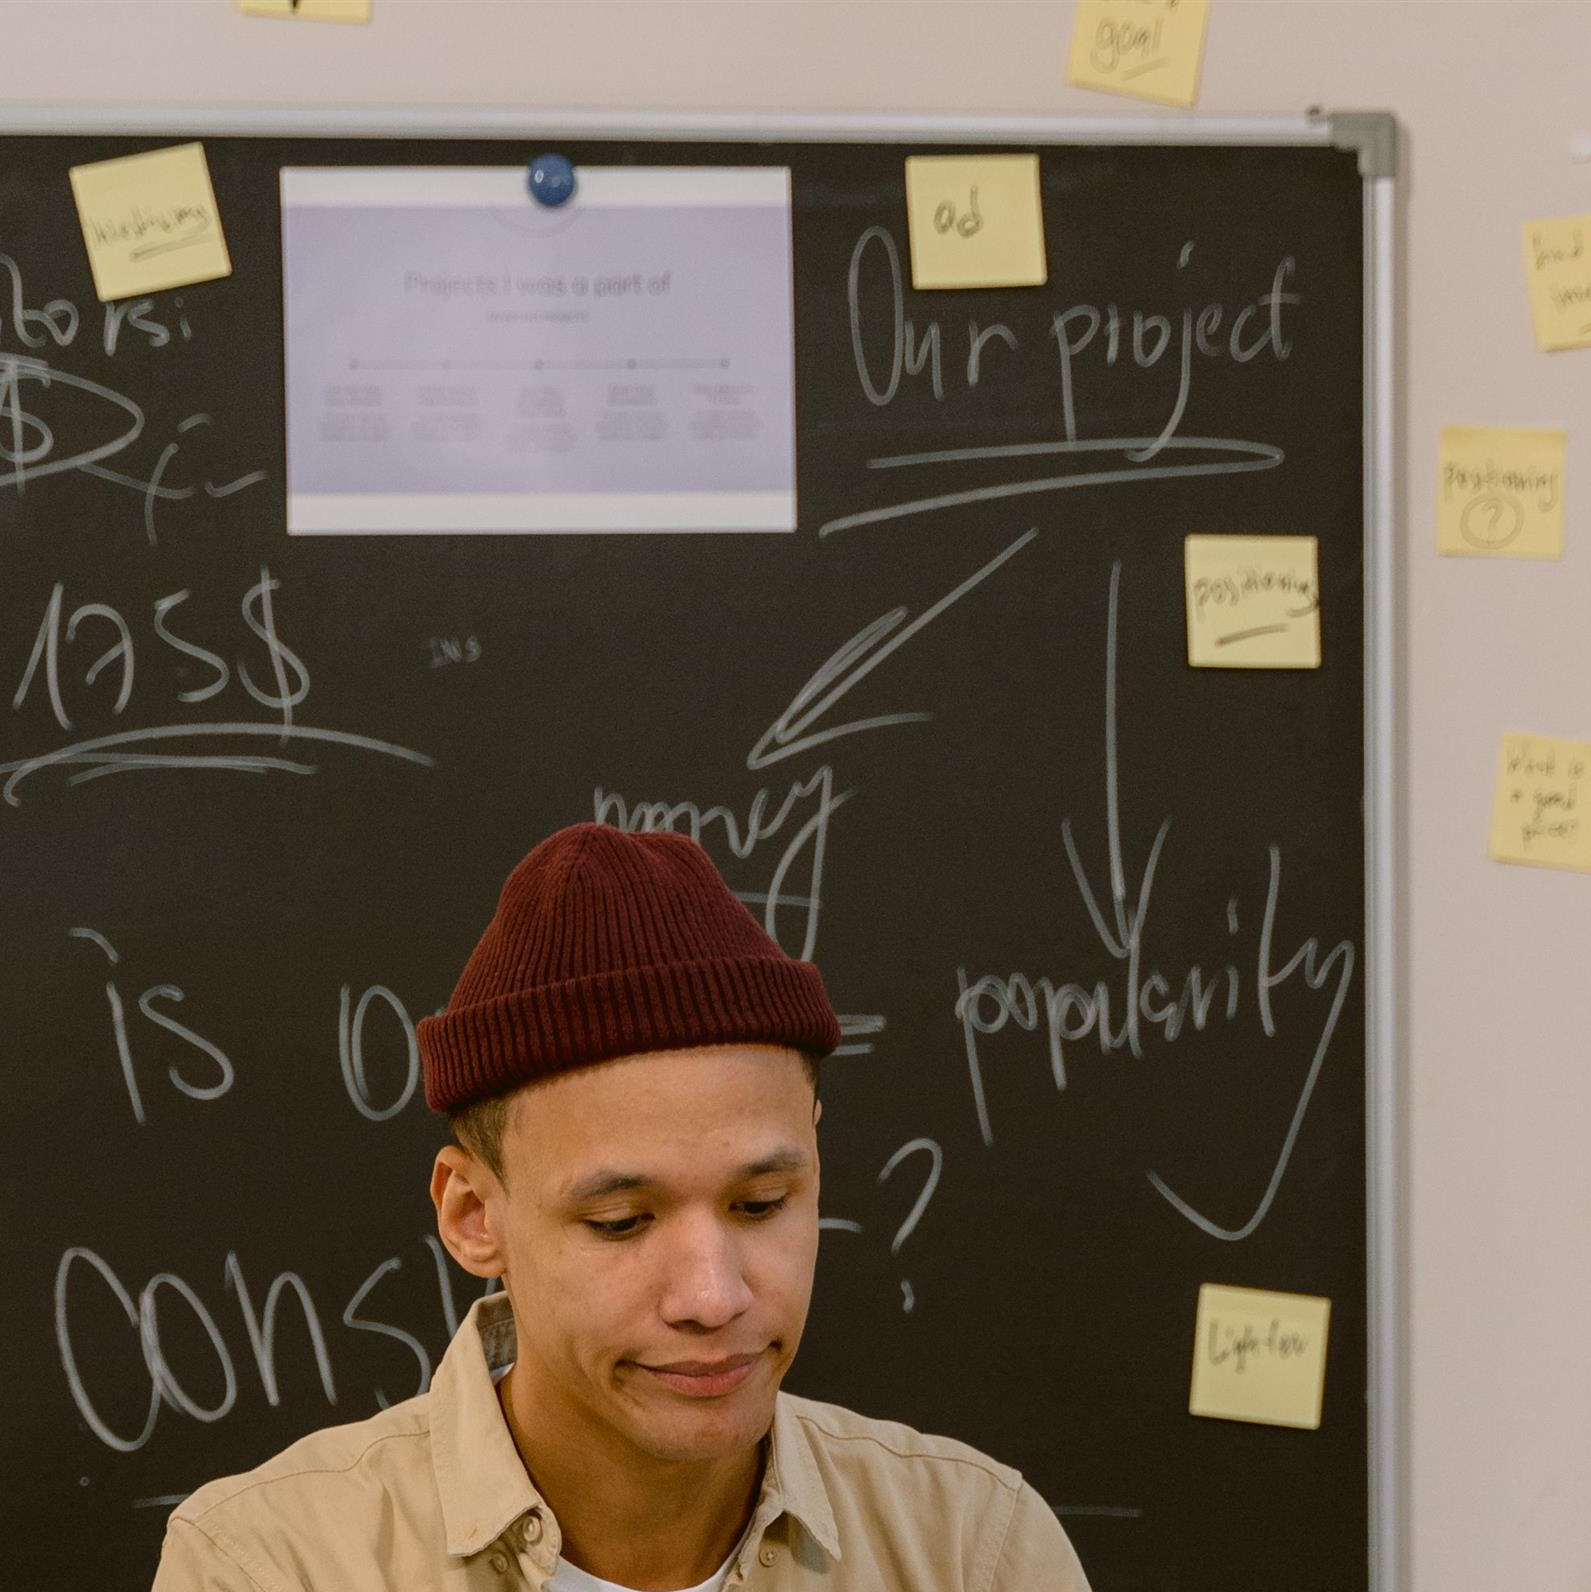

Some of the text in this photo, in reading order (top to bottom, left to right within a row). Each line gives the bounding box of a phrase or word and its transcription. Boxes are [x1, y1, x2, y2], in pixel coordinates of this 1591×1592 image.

[848, 225, 1301, 463] Our project
[68, 925, 235, 1125] is
